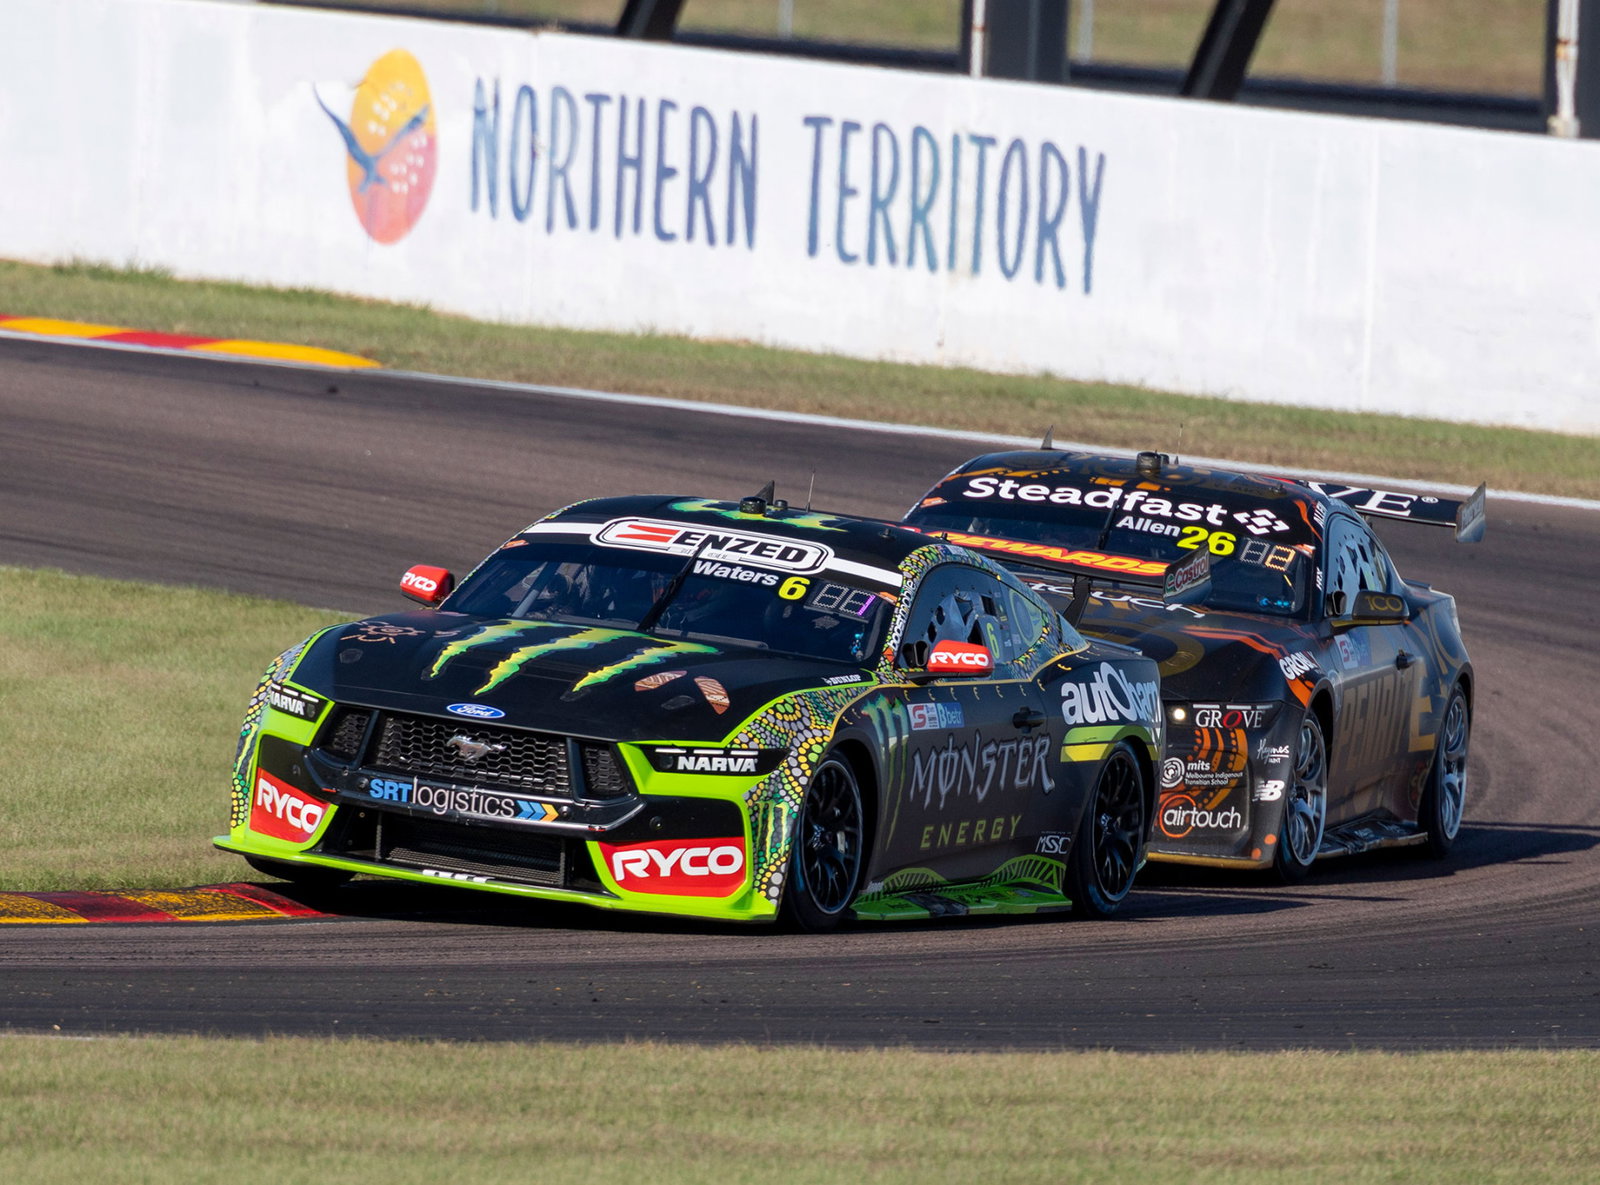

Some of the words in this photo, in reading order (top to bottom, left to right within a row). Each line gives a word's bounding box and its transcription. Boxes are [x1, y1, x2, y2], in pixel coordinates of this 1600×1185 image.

[471, 77, 758, 249] NORTHERN
[804, 116, 1105, 295] TERRITORY
[962, 476, 1228, 526] Steadfast
[672, 530, 809, 563] ENZED
[1116, 515, 1181, 537] Allen
[1176, 526, 1237, 556] 26
[693, 560, 779, 586] Waters
[778, 576, 811, 600] 6
[1174, 550, 1210, 590] Castrol
[930, 652, 989, 666] RYCO
[1195, 710, 1263, 728] GROVE
[677, 756, 757, 773] NARVA
[910, 729, 1055, 811] MONSTER
[1186, 771, 1214, 779] Melbourne
[1187, 760, 1211, 771] mits
[257, 777, 323, 834] RYCO
[1163, 806, 1242, 829] airtouch
[920, 815, 1022, 848] ENERGY
[611, 846, 744, 881] RYCO
